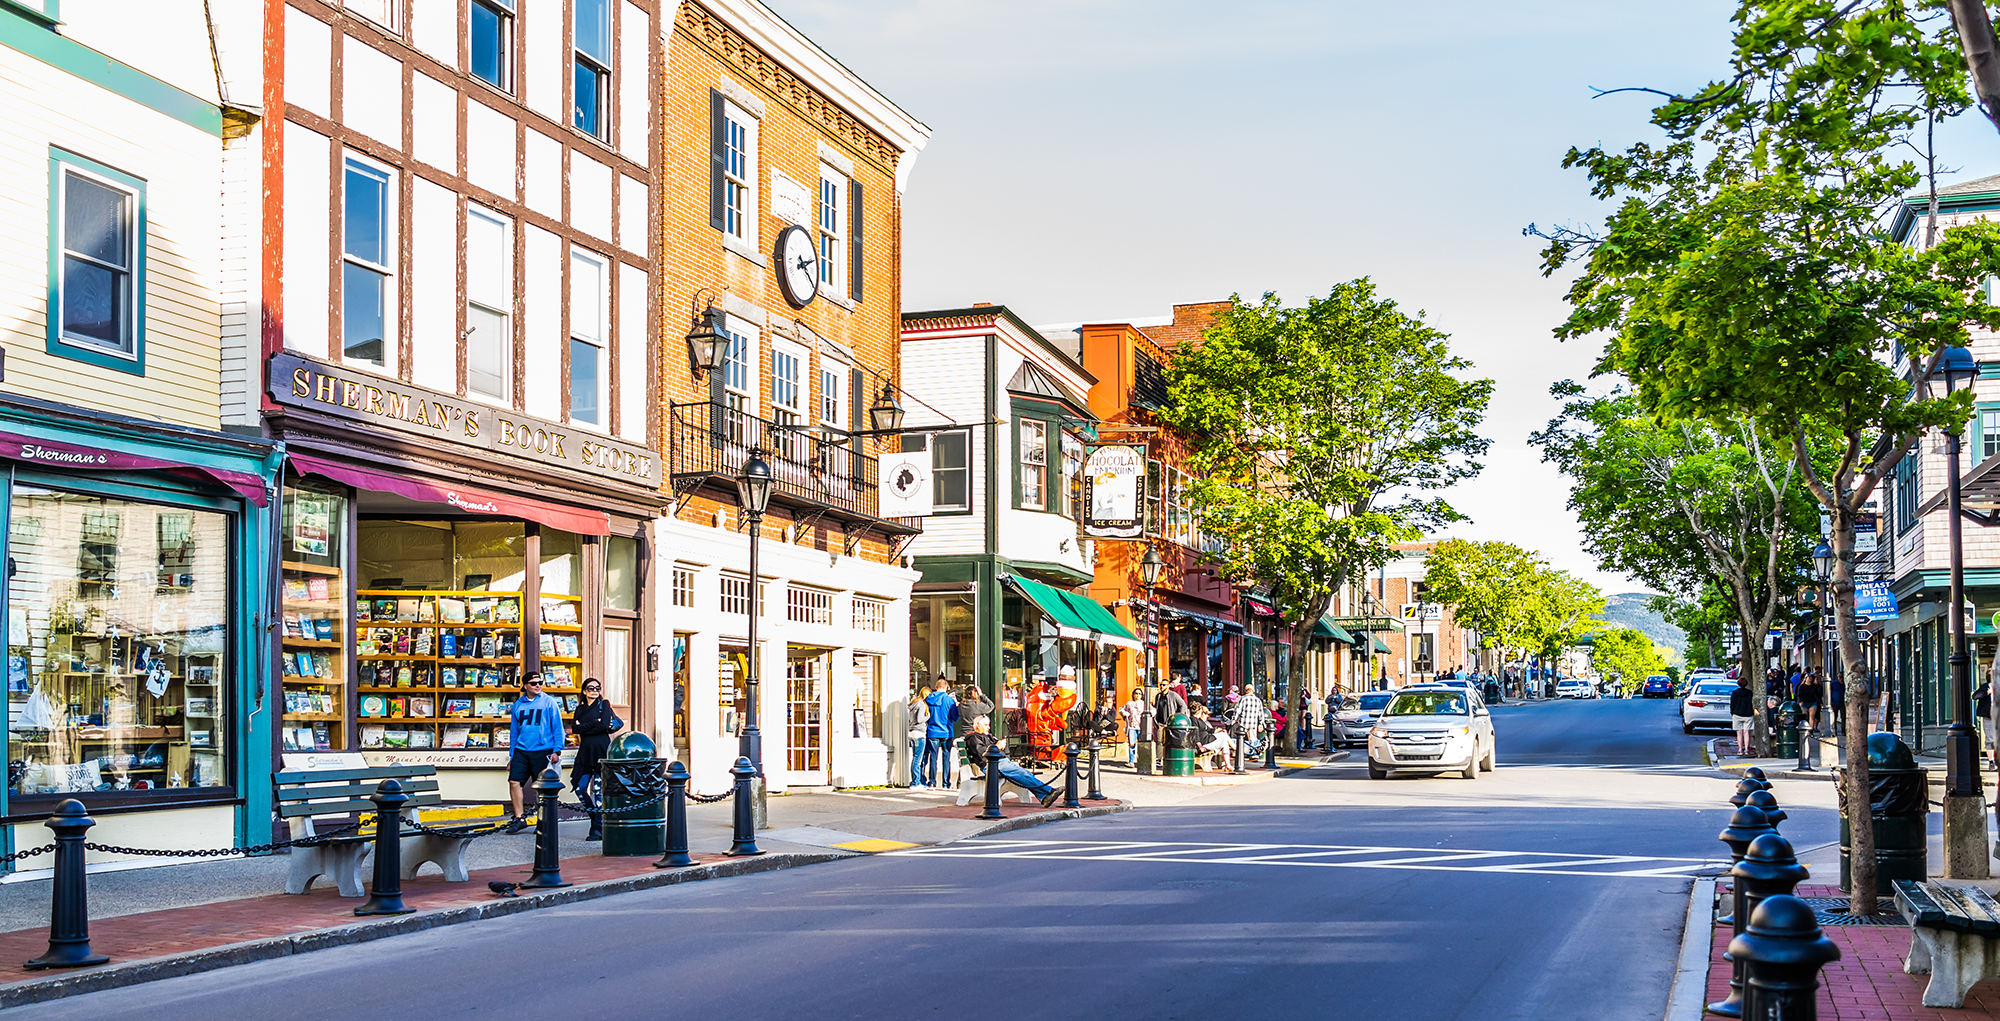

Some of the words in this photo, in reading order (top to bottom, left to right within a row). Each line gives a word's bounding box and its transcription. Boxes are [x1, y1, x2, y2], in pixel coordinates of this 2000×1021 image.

[292, 367, 480, 438] SHERMAN'S
[498, 419, 567, 459] BOOK
[581, 440, 652, 480] STORE
[1085, 456, 1145, 466] CHOCOLATE
[447, 491, 499, 512] Sherman's
[1855, 581, 1891, 590] WNEAST
[1862, 588, 1889, 597] DELI
[519, 708, 543, 727] HI
[307, 756, 343, 769] Sherman's
[385, 755, 421, 763] Maine's
[426, 755, 455, 763] Oldest
[458, 755, 500, 763] Bookstore
[66, 769, 93, 781] SHORE
